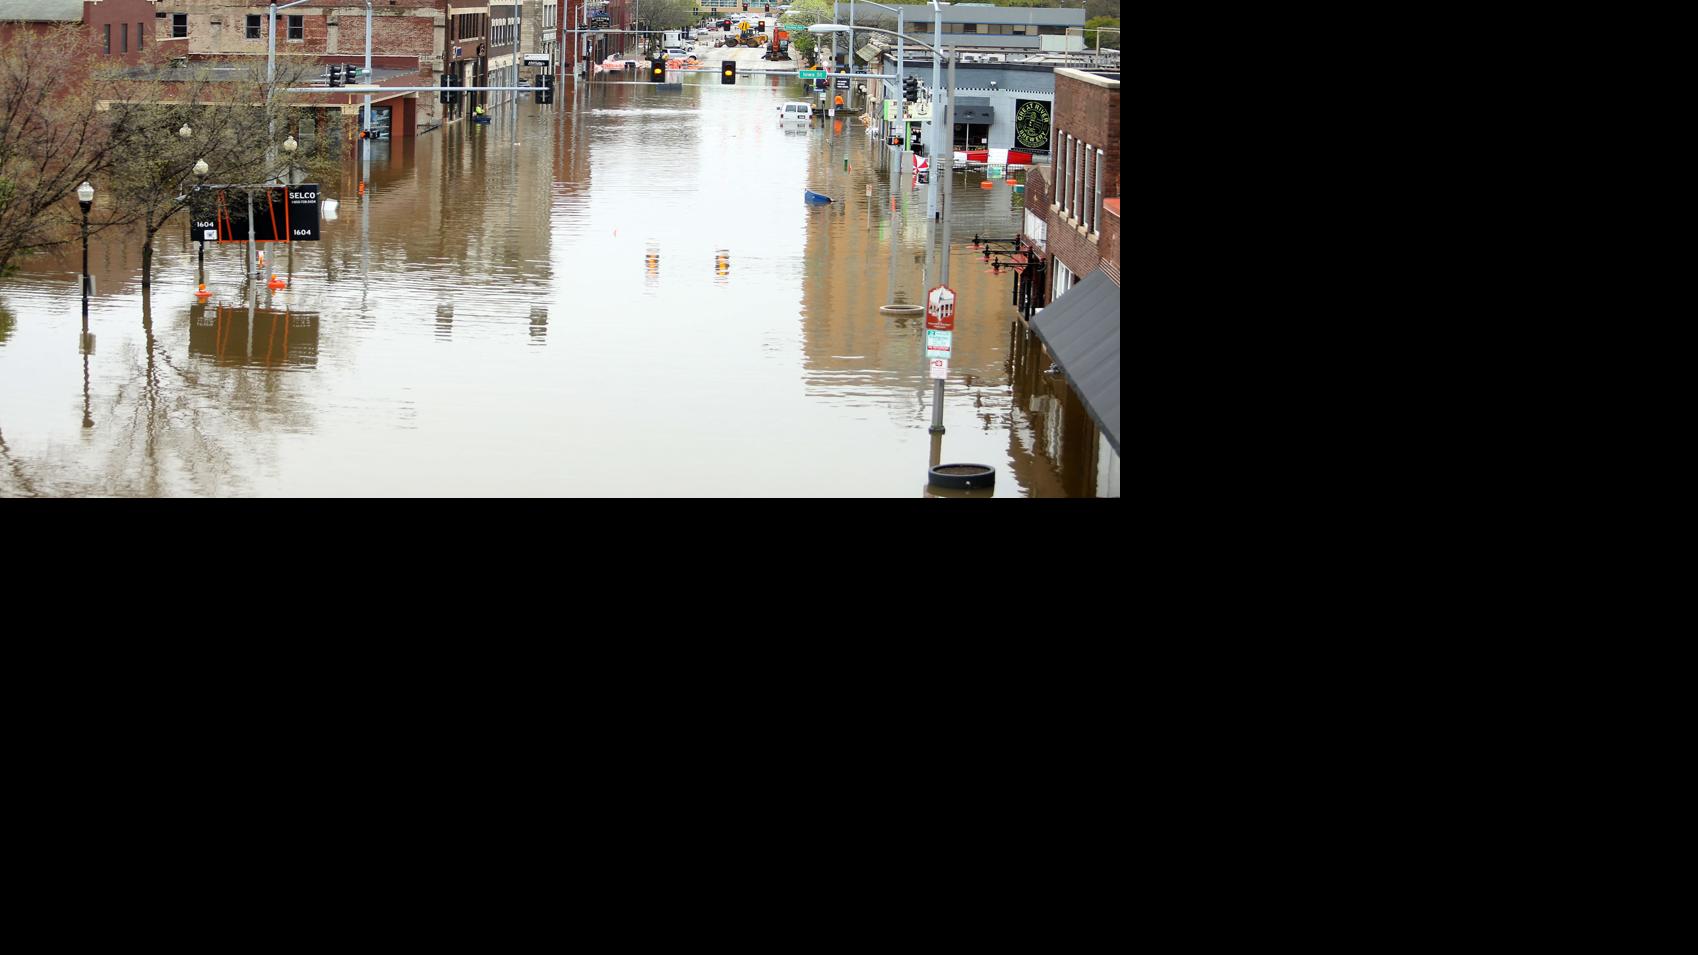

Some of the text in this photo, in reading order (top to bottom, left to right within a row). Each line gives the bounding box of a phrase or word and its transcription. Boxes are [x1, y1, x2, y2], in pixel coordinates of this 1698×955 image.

[1017, 103, 1049, 123] GREAT RIVER
[1019, 129, 1046, 142] BREWERY
